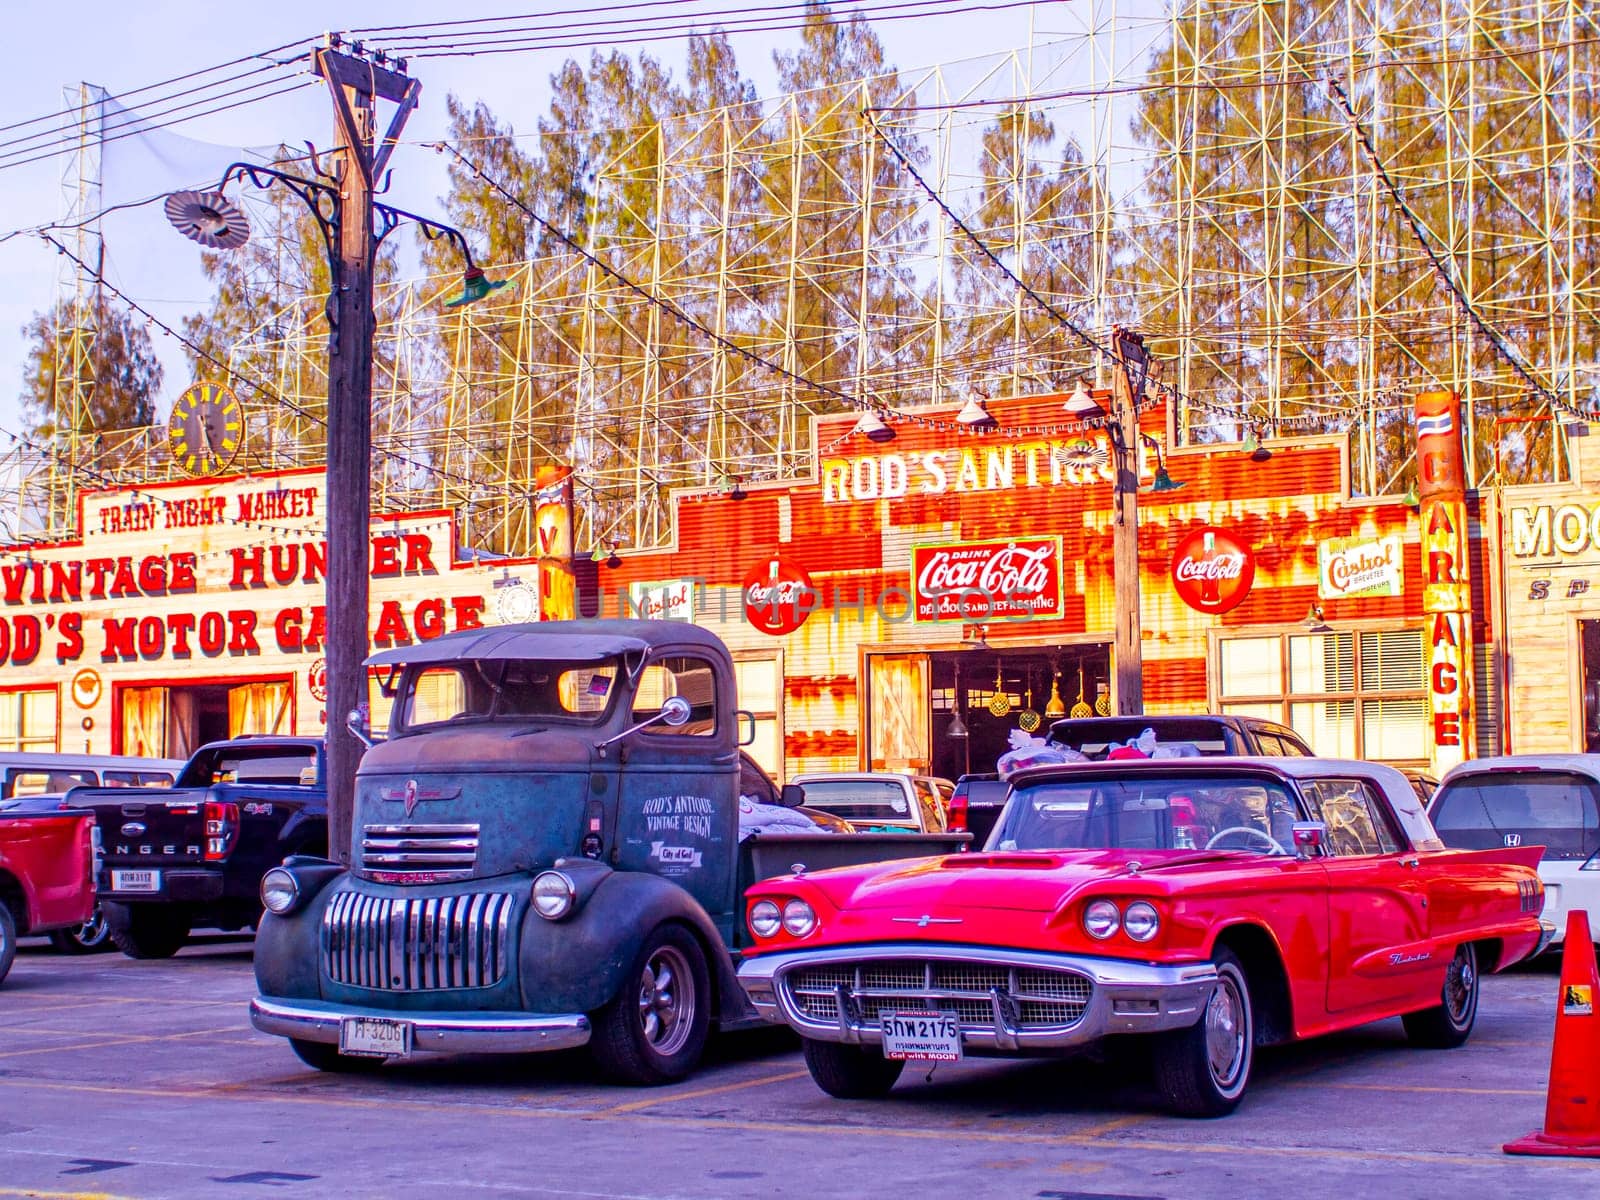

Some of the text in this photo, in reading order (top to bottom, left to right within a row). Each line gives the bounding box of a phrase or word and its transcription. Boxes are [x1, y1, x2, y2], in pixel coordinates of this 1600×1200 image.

[822, 450, 947, 503] ROD'S
[99, 487, 318, 534] TRAIN NIGHT MARKET
[1511, 504, 1600, 557] MO
[1, 534, 438, 605] VINTAGE HUNER
[918, 543, 1054, 598] Coca-Cola
[951, 549, 992, 560] DRINK
[1329, 543, 1392, 591] Castrol
[100, 609, 261, 663] MOTOR
[275, 596, 485, 652] GAAGE
[920, 602, 970, 615] DELICIOUS
[972, 602, 988, 612] AND
[642, 796, 714, 814] ROD'S ANTIQUE
[647, 816, 711, 838] VINTAGE DESIGN
[919, 1021, 957, 1038] 2175
